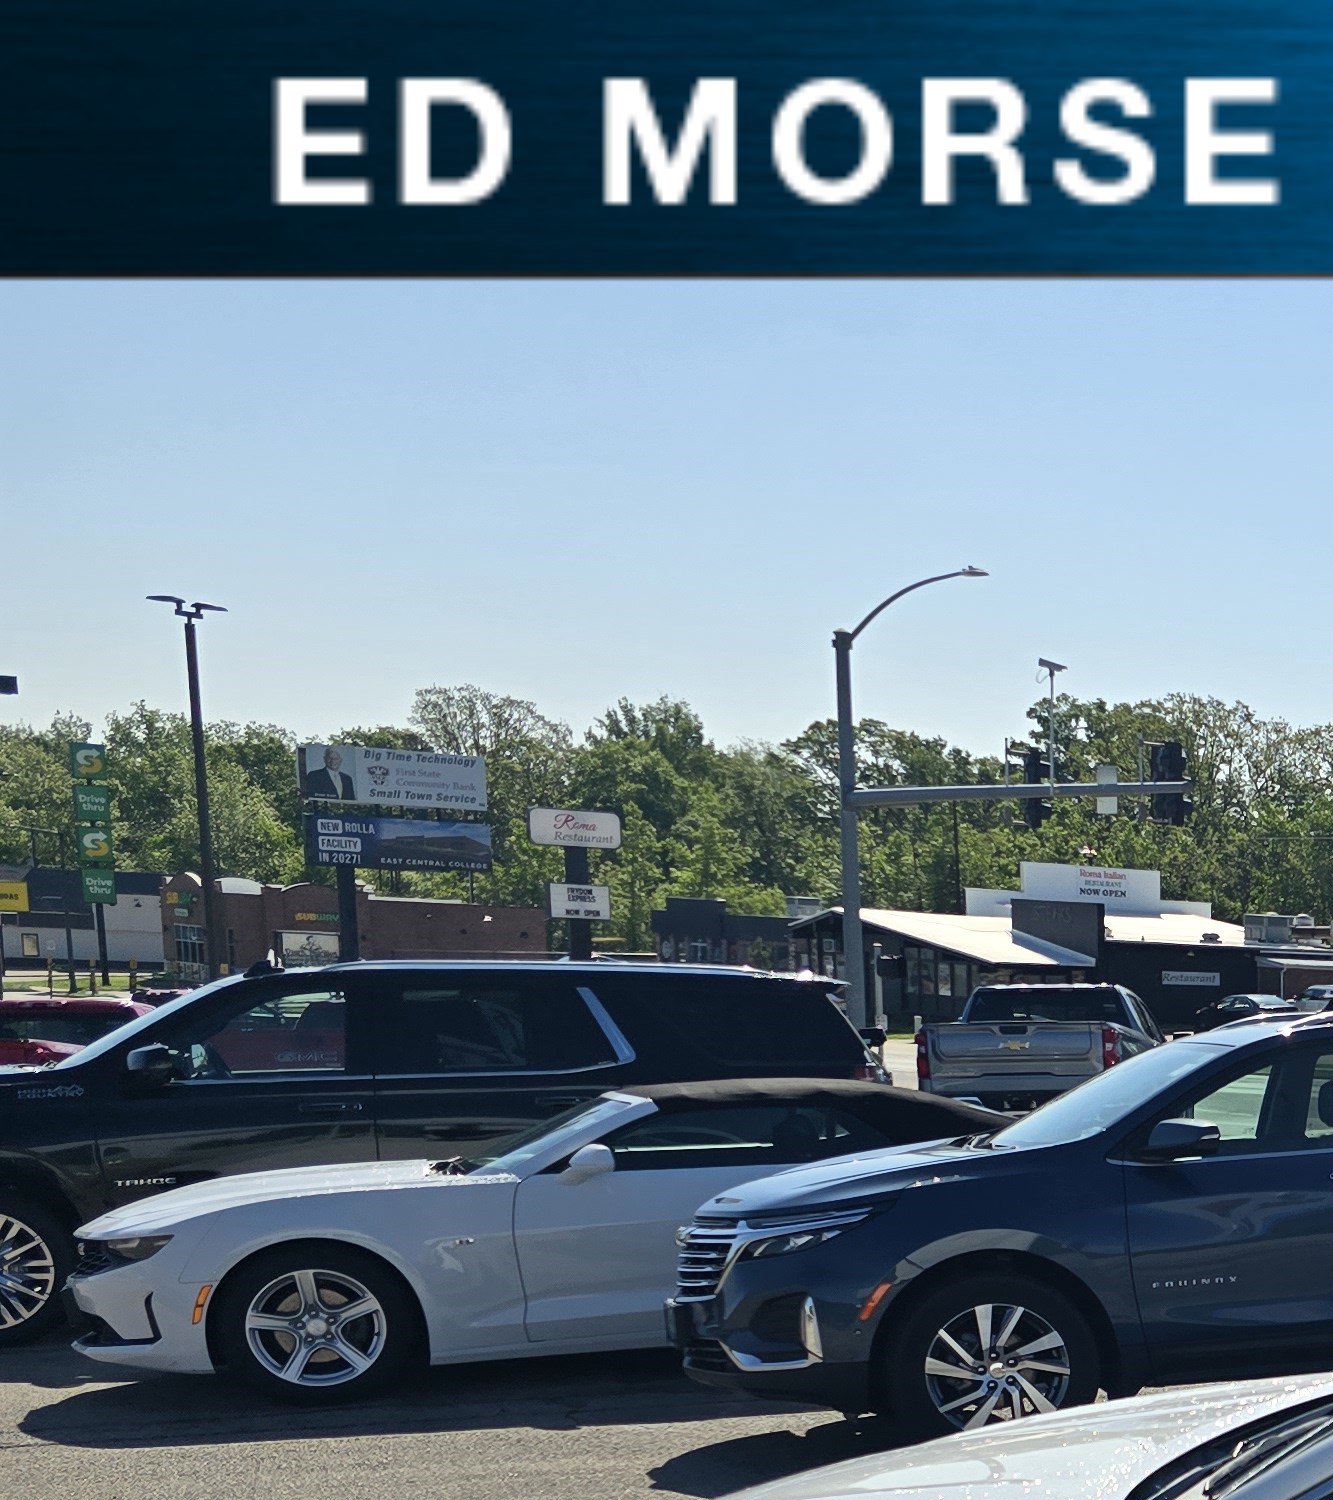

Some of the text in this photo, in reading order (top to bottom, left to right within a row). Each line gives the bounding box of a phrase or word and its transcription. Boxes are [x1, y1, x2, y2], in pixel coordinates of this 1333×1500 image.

[364, 750, 477, 768] Big Time Technology
[417, 769, 441, 778] State
[452, 781, 477, 791] Bank
[369, 788, 477, 804] Small Town Service
[79, 794, 106, 812] Drive thru
[320, 821, 375, 834] NEW ROLLA
[553, 813, 598, 831] Roma
[554, 831, 613, 844] Restaurant
[321, 838, 359, 850] FACILITY
[318, 852, 330, 863] IN
[380, 857, 488, 870] EAST CENTRAL COLLEGE
[1079, 868, 1127, 880] Roma Italian
[86, 877, 113, 894] Drive thru
[1079, 887, 1127, 898] NOW OPEN
[1162, 973, 1216, 984] Restaurant
[114, 1177, 177, 1187] TAHOE
